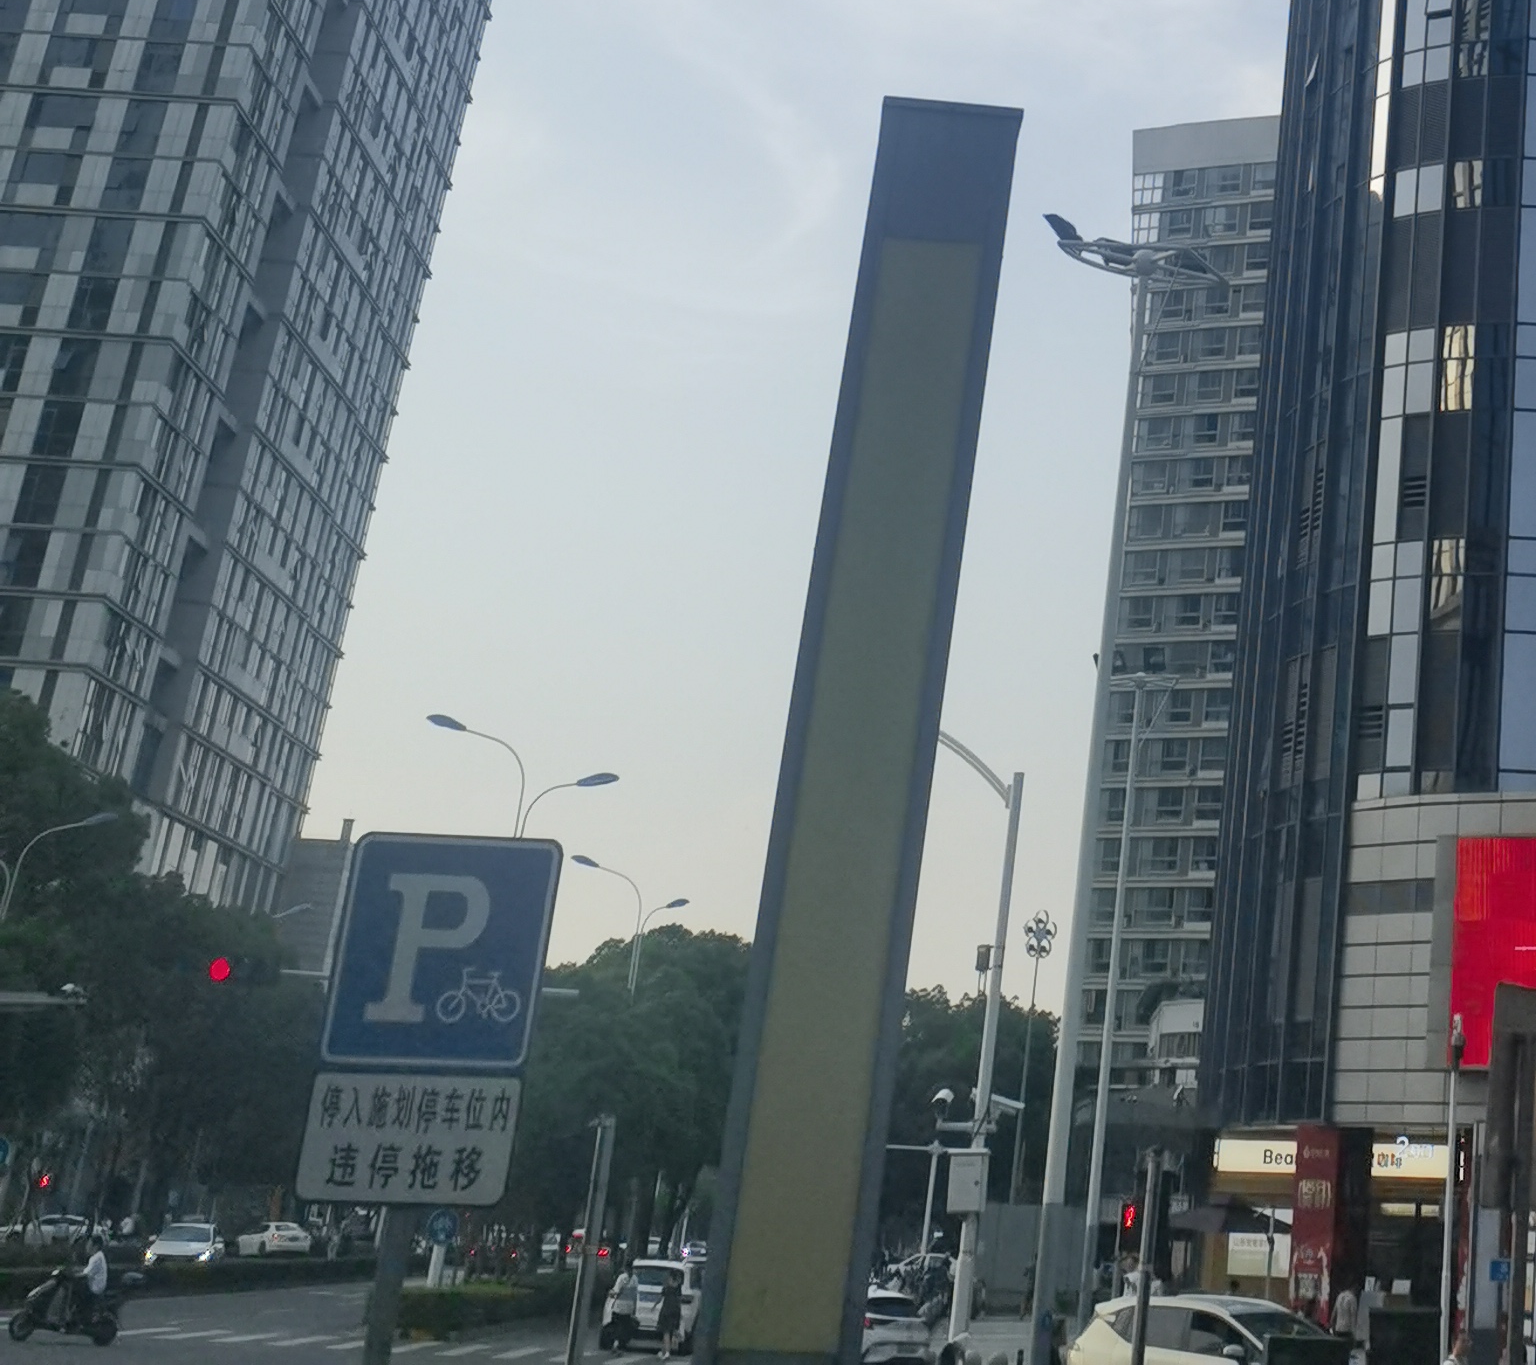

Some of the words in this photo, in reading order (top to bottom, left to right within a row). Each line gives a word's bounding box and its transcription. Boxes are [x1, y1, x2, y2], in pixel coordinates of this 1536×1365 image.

[363, 872, 491, 1023] P
[320, 1084, 512, 1135] 停入施划停车位内
[326, 1142, 484, 1192] 违停拖移
[1263, 1148, 1297, 1166] Bea
